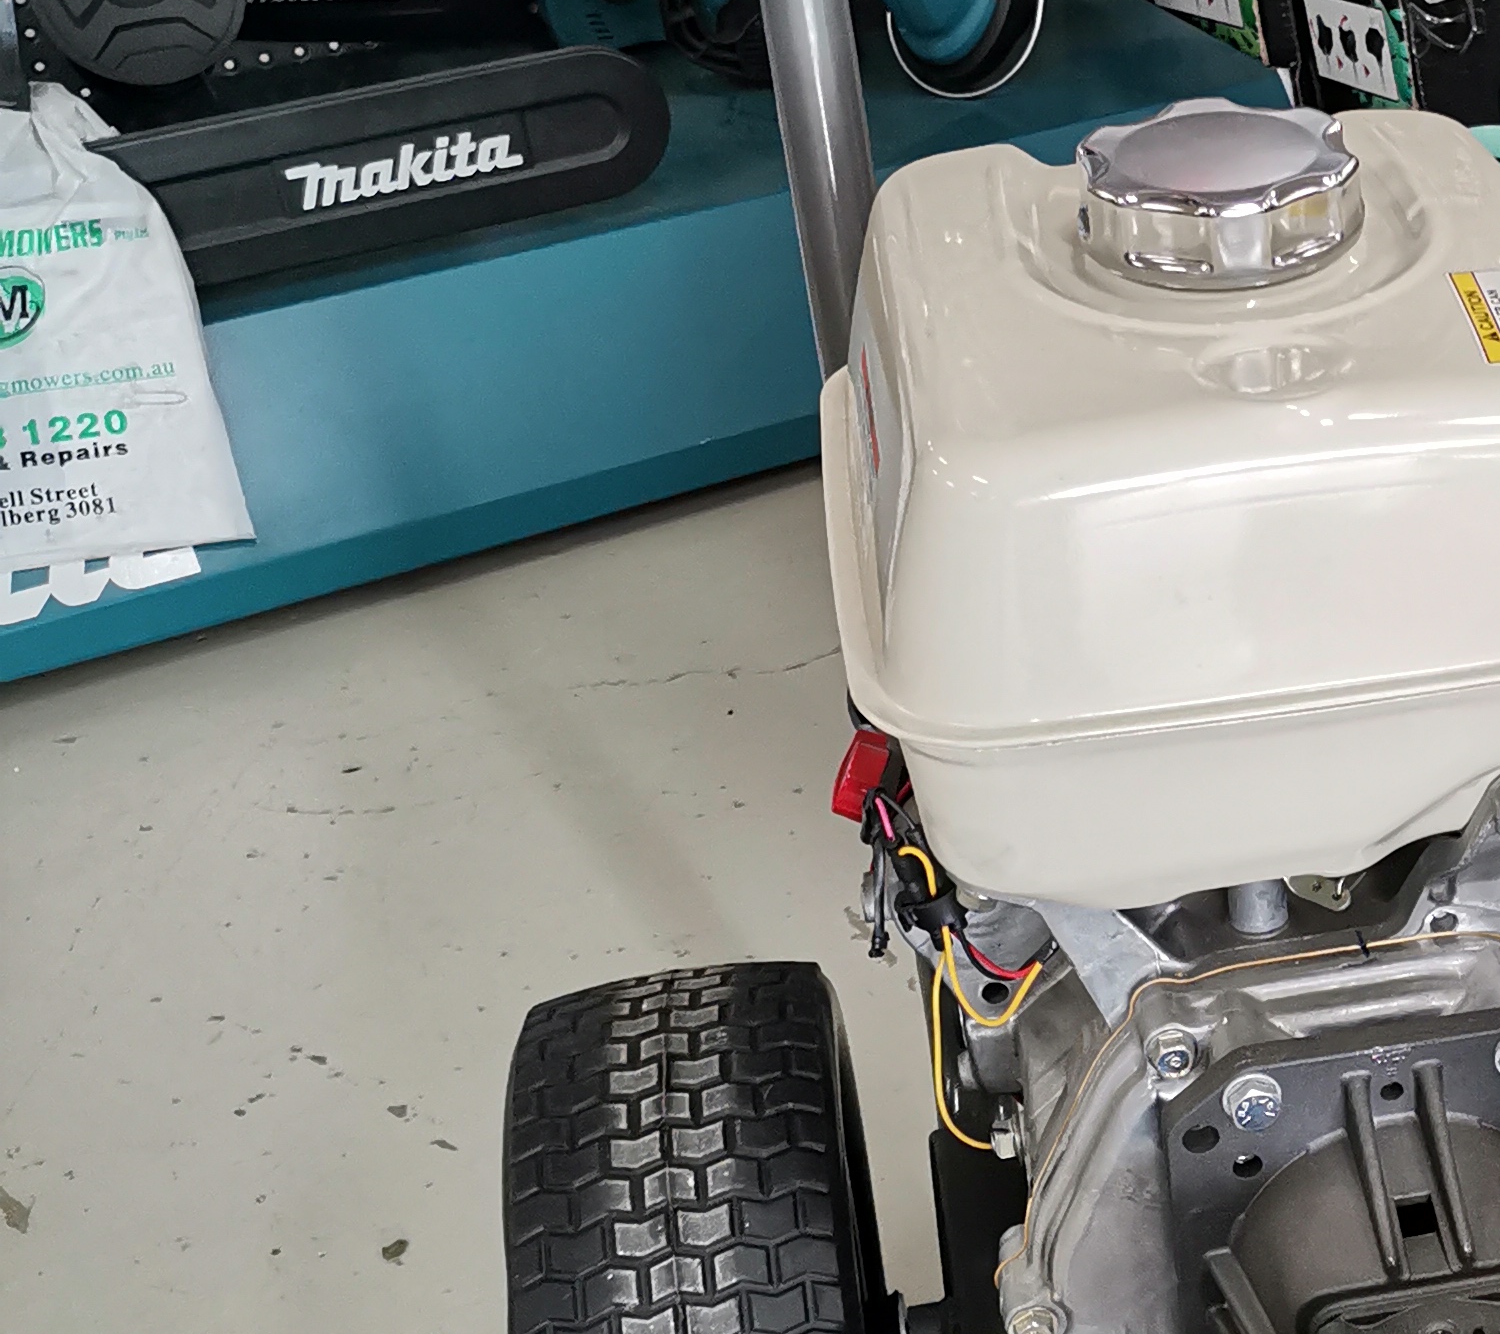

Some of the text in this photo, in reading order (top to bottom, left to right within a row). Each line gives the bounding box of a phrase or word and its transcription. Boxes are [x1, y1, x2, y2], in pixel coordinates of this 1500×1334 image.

[1462, 289, 1495, 330] CAUTION
[22, 409, 128, 446] 1220
[21, 441, 129, 468] Repairs
[31, 482, 99, 506] Street
[66, 496, 117, 519] 3081
